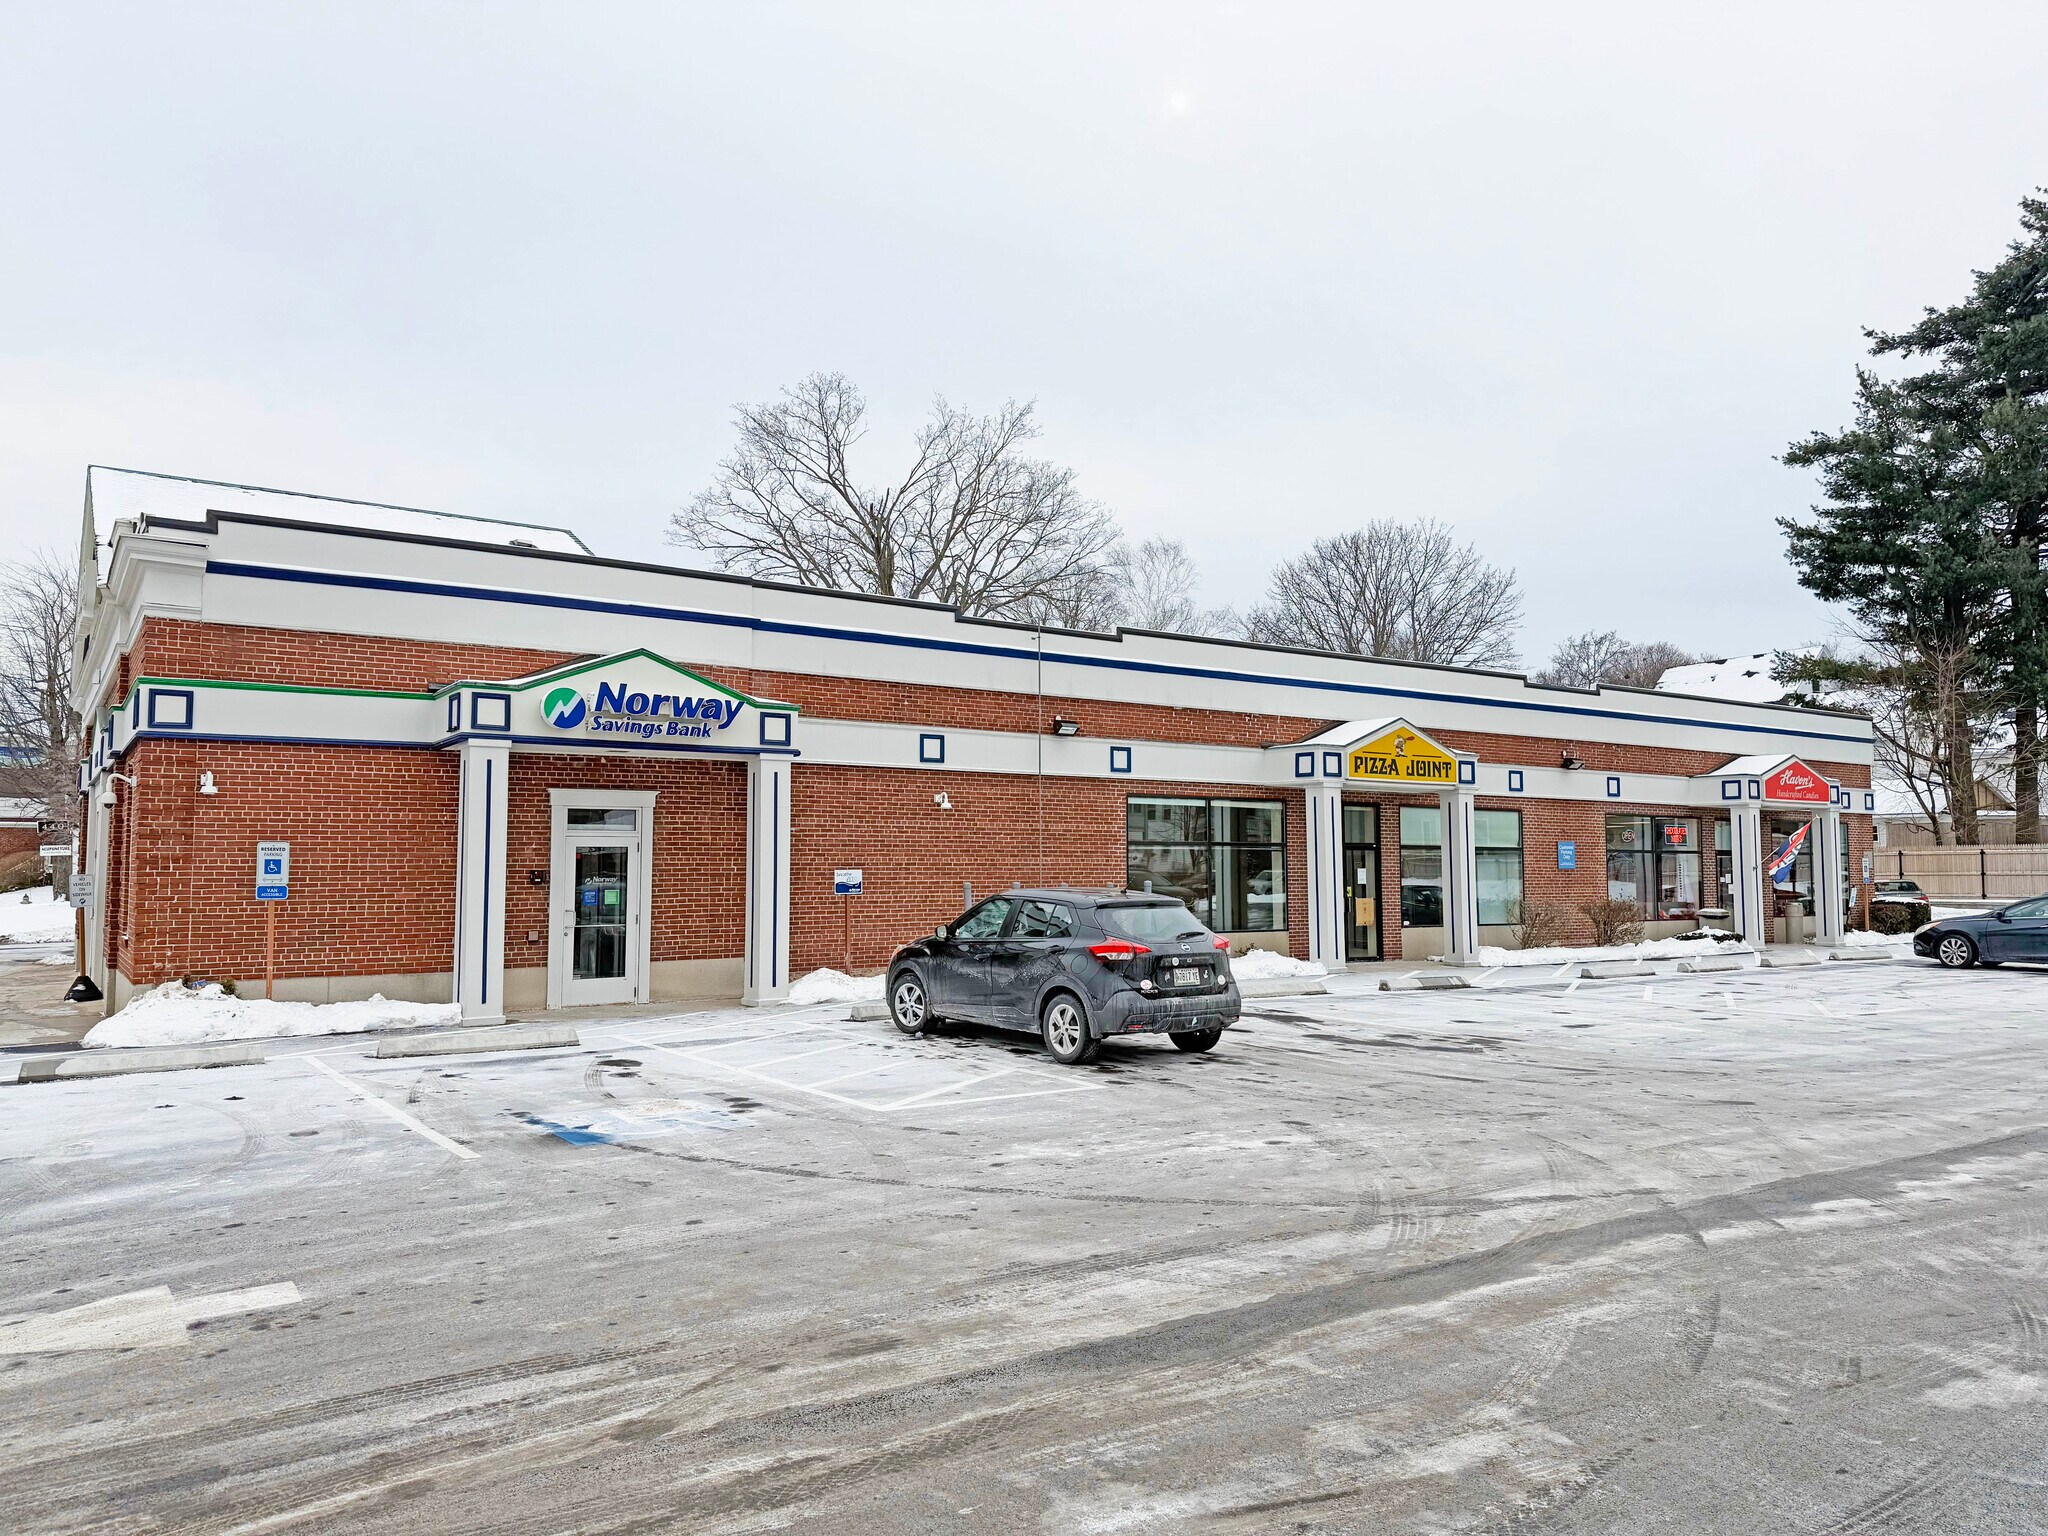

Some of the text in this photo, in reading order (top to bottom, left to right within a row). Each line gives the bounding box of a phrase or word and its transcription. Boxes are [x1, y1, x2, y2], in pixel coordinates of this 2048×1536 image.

[595, 682, 745, 729] Norway
[591, 716, 711, 738] Savings Bank
[1354, 756, 1452, 778] PIZZA JOINT
[1776, 790, 1819, 799] Handcrafted Candies
[592, 876, 618, 884] Norway
